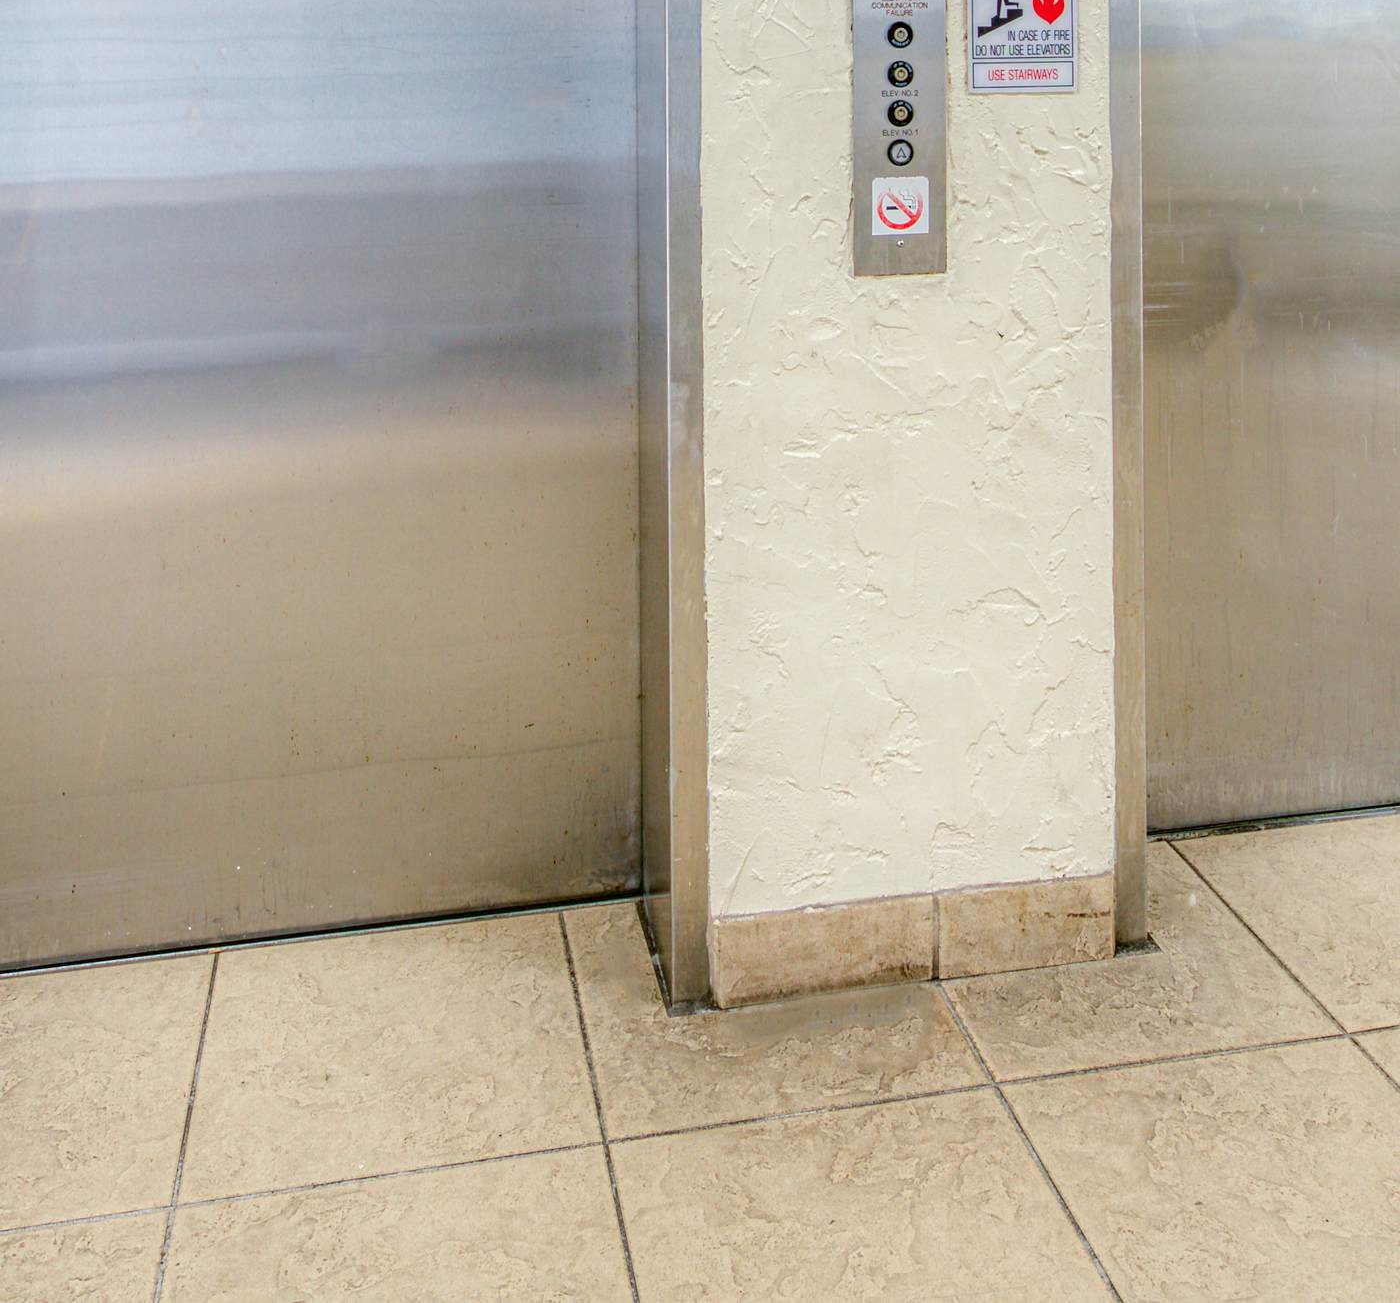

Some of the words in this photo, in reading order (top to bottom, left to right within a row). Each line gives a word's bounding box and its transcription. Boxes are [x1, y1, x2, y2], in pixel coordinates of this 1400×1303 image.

[1008, 30, 1016, 41] IN
[1018, 30, 1038, 42] CASE
[1040, 30, 1052, 41] OF
[1054, 29, 1071, 41] FIRE
[976, 45, 987, 56] DO
[990, 44, 1006, 56] NOT
[1008, 44, 1024, 56] USE
[1027, 44, 1071, 56] ELEVATORS
[988, 70, 1005, 81] USE
[1008, 68, 1059, 80] STAIRWAYS
